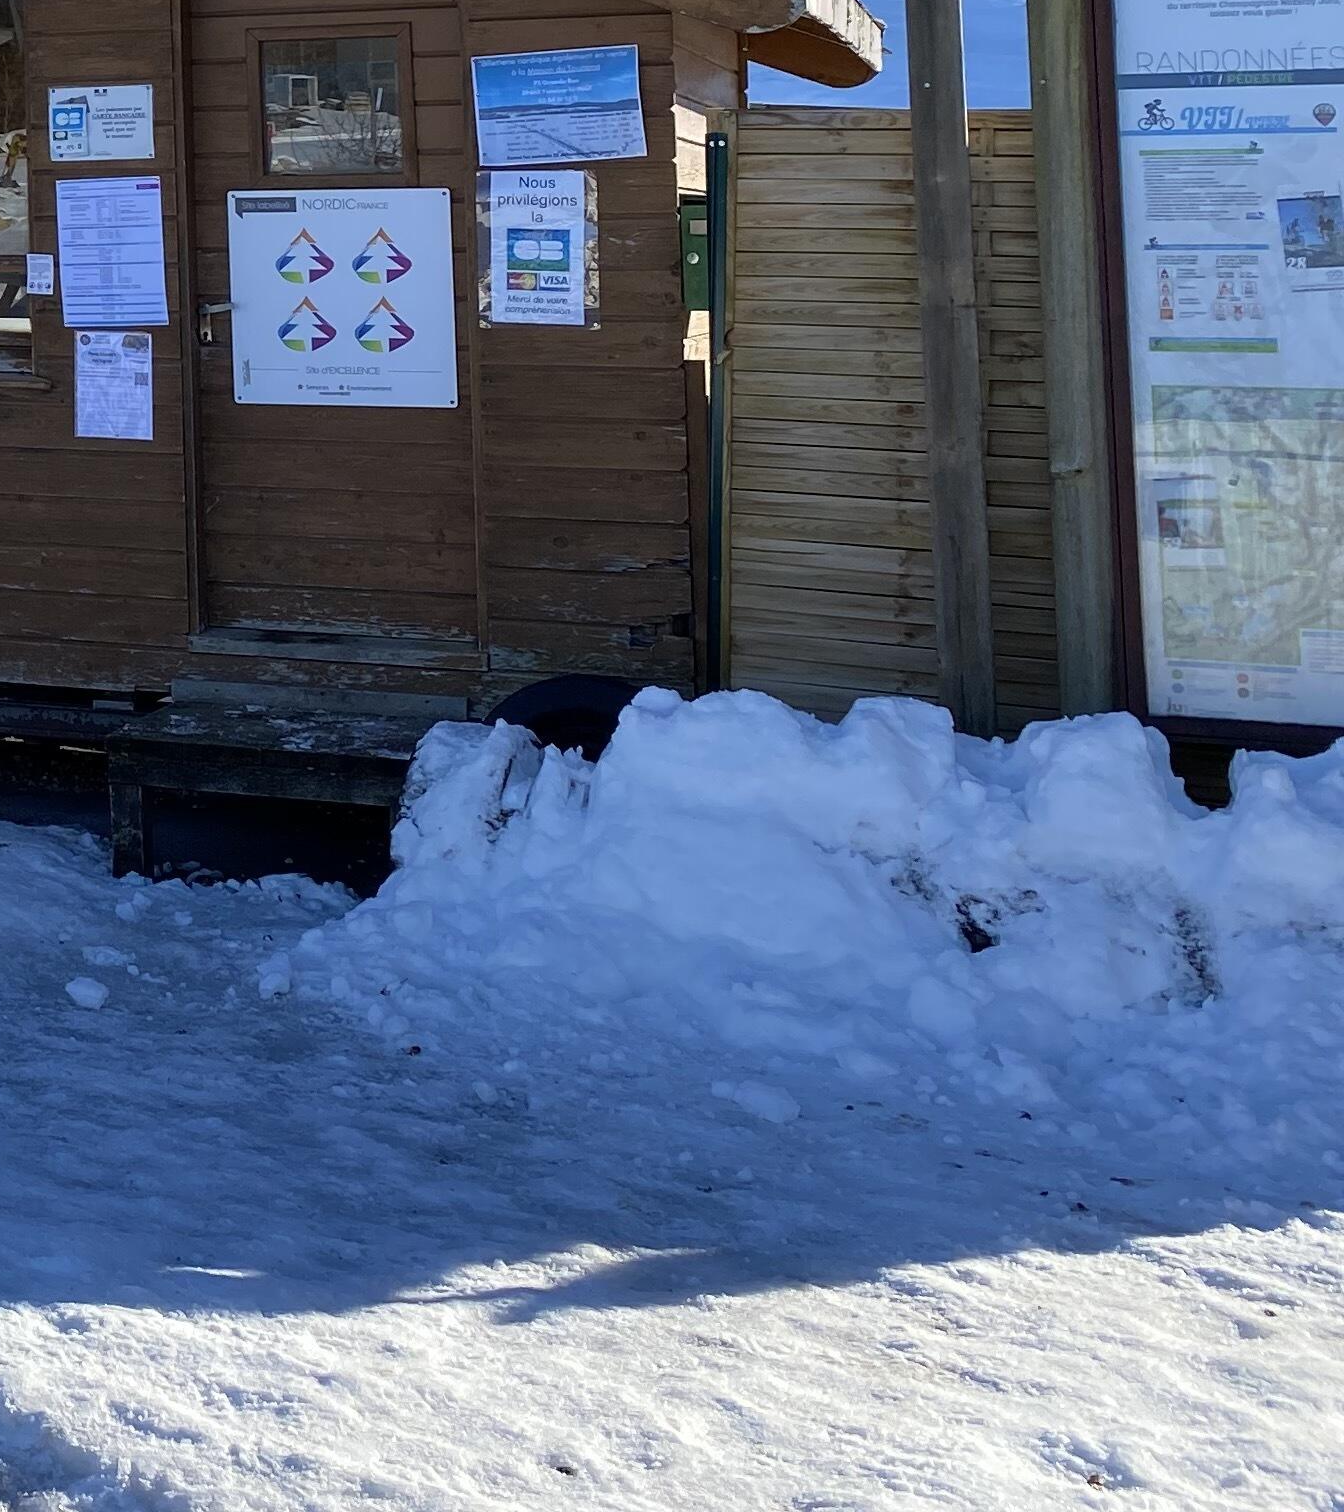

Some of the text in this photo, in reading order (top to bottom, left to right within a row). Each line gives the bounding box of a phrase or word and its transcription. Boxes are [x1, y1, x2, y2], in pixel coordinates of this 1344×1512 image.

[1136, 41, 1344, 74] RANDONNÉES
[519, 176, 556, 189] Nous
[302, 198, 357, 210] NORDIC
[357, 201, 389, 210] FRANCE
[497, 193, 578, 208] privilégions
[531, 211, 544, 223] la
[542, 275, 569, 286] VISA
[507, 295, 531, 304] Merci
[533, 296, 544, 304] de
[505, 306, 571, 315] compréhension
